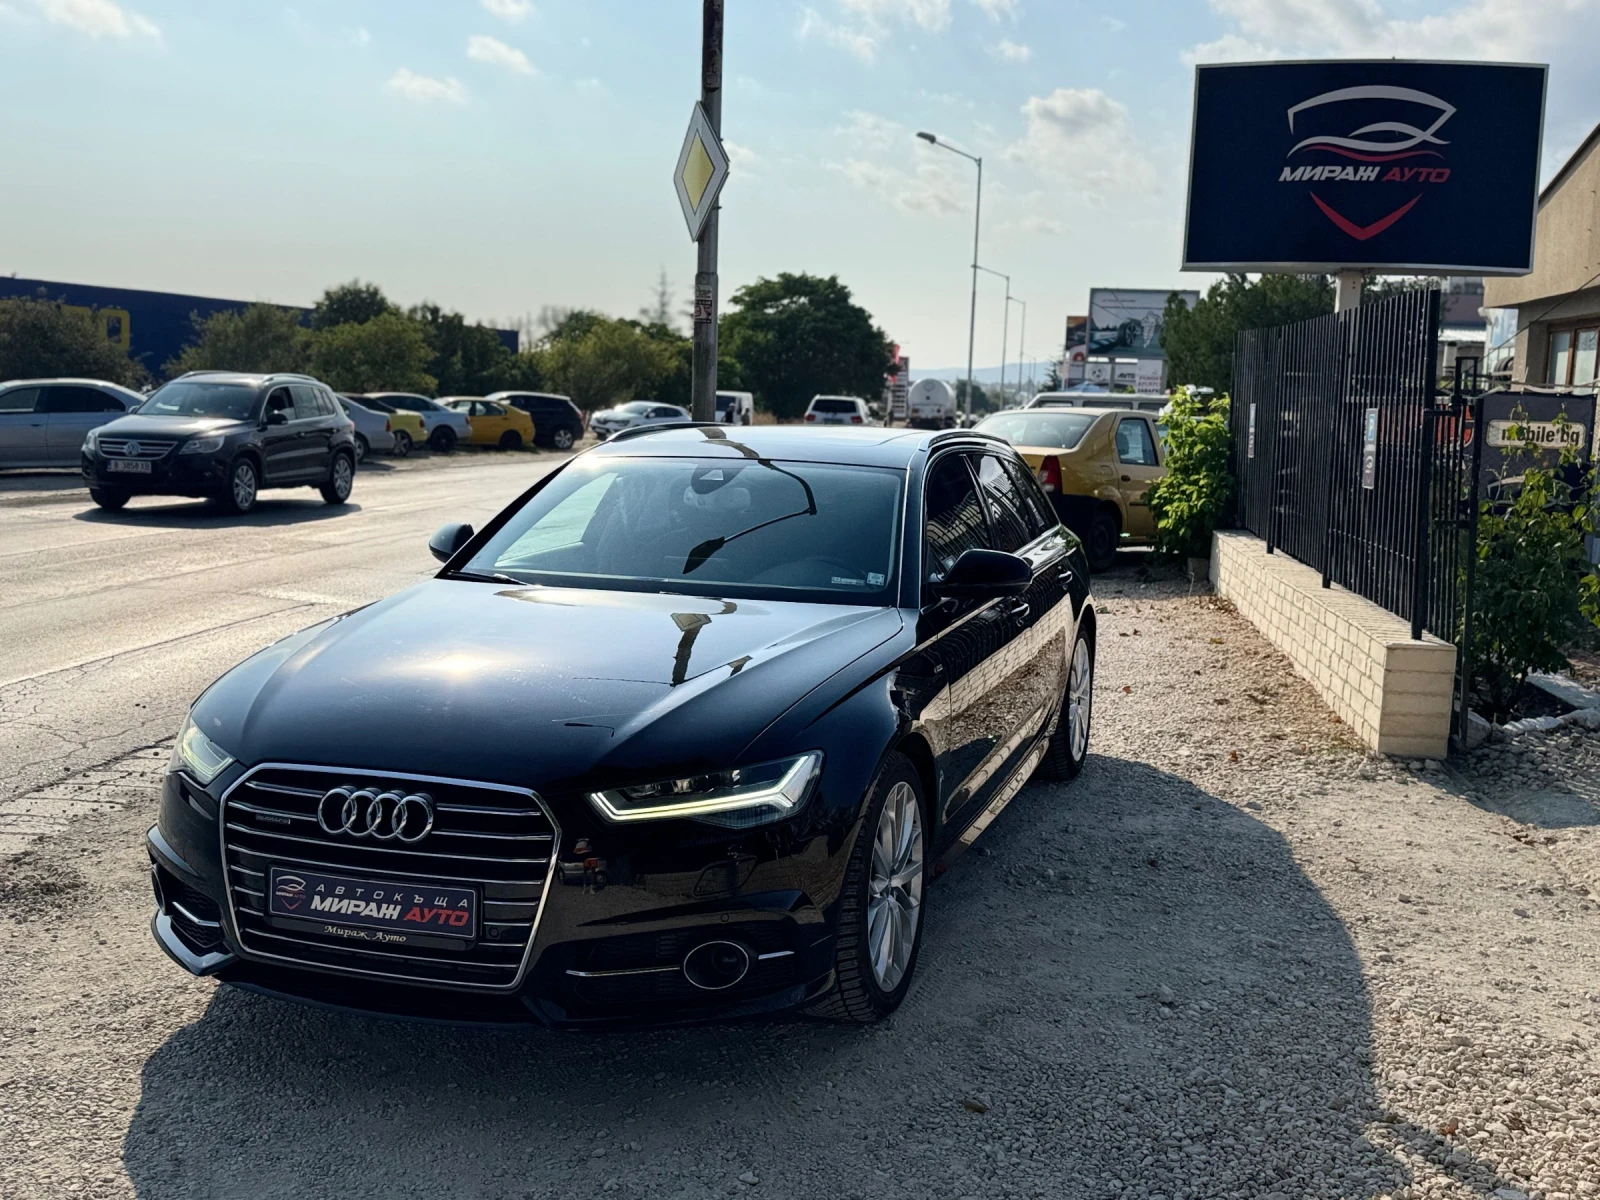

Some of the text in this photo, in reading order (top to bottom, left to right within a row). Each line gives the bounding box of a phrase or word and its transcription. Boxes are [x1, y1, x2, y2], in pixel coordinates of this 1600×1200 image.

[1278, 165, 1451, 183] МИРАЖ АУТО
[310, 895, 469, 926] МИРАЖ АУТО
